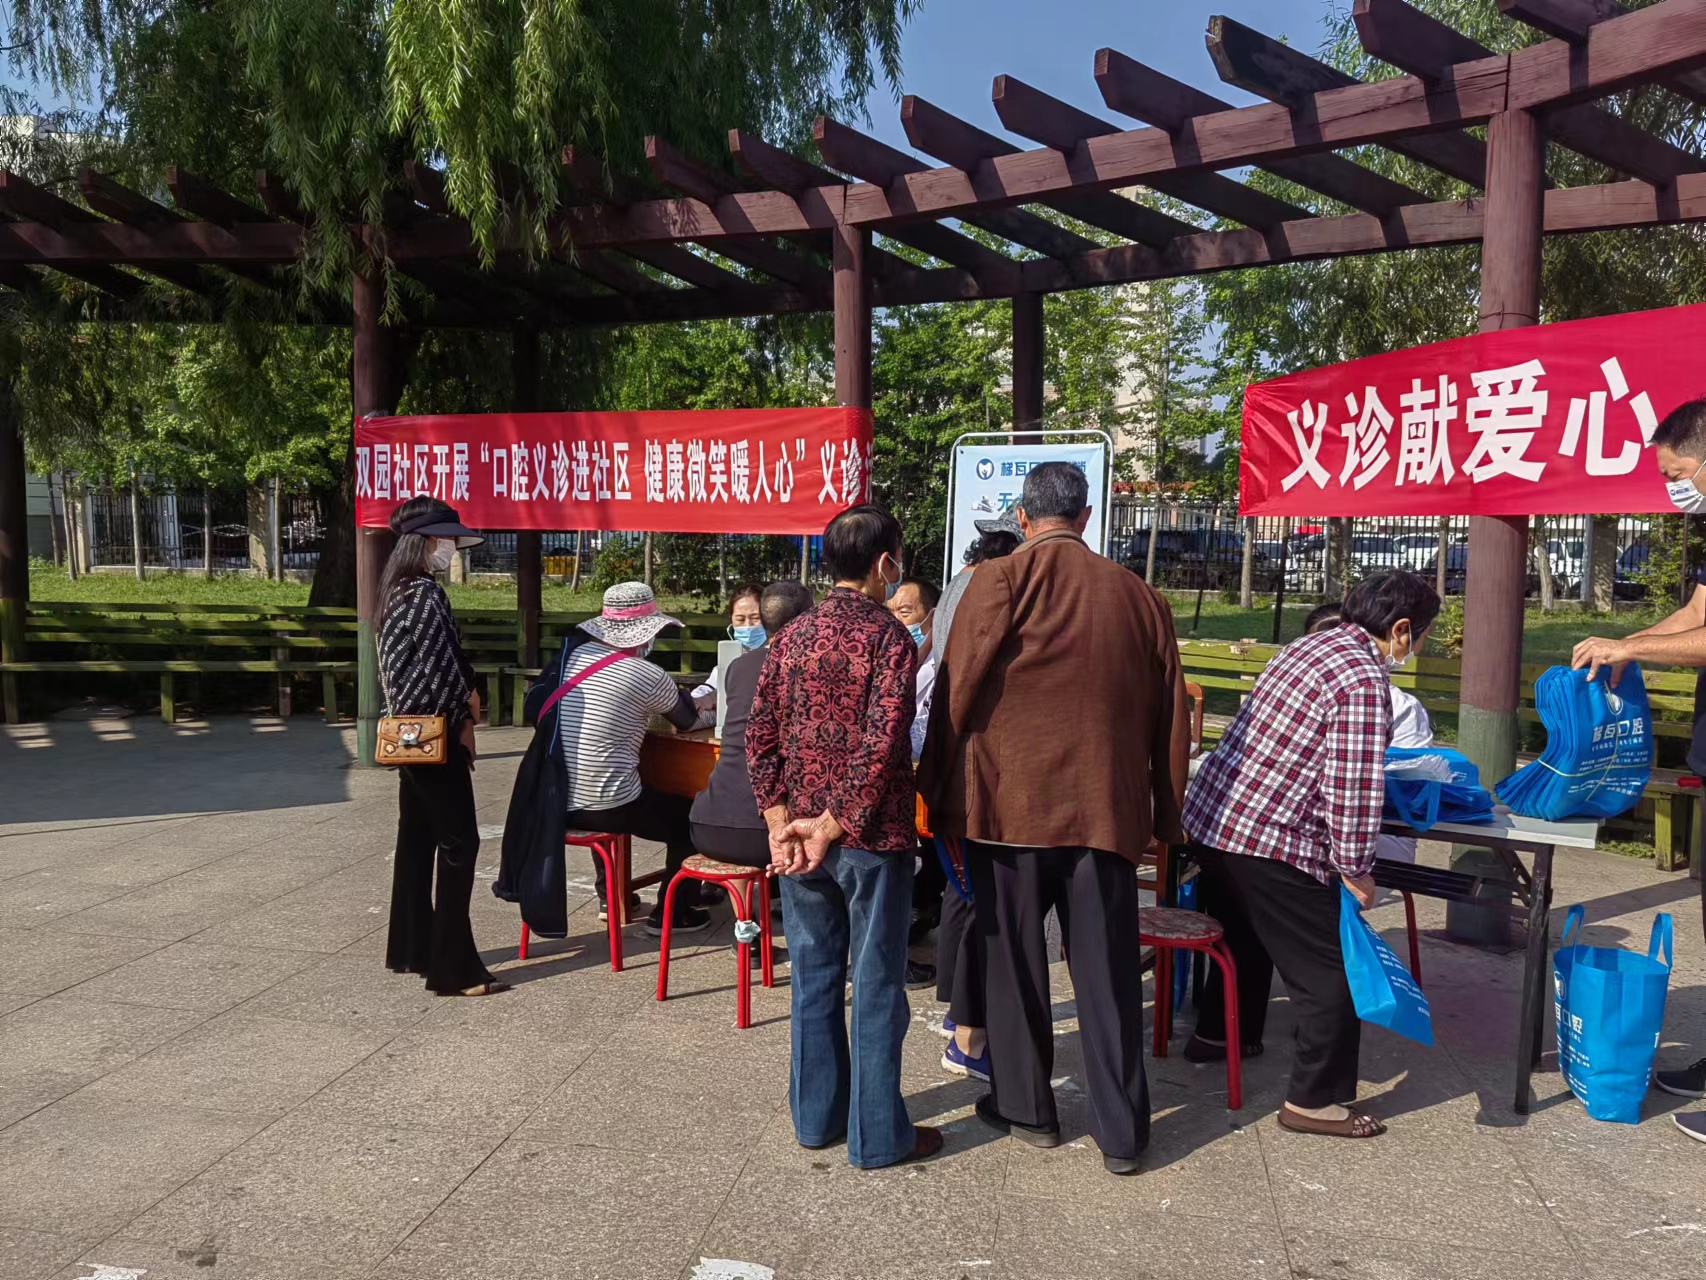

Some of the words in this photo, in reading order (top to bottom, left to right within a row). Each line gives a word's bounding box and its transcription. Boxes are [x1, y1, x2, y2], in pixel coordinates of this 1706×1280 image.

[1281, 356, 1660, 493] 义诊献爱心
